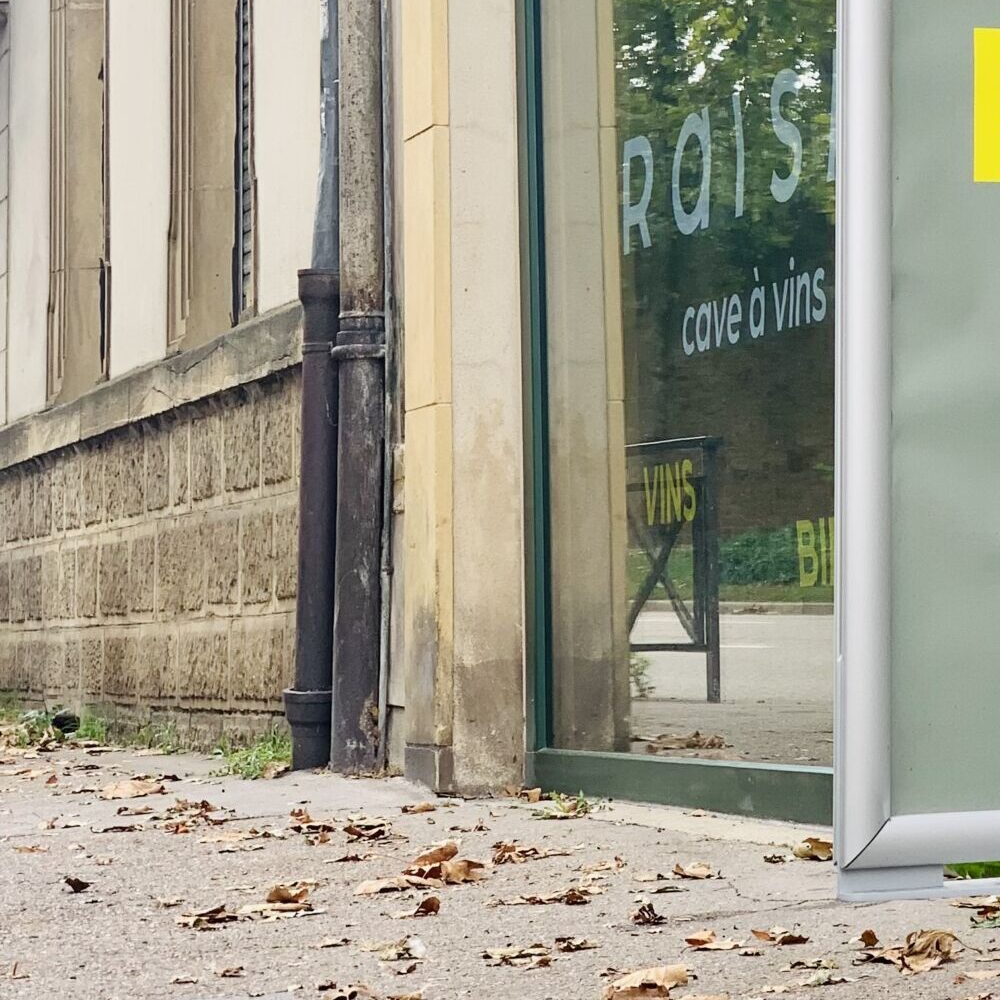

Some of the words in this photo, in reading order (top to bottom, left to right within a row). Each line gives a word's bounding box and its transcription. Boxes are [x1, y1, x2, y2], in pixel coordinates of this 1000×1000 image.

[681, 293, 742, 356] cave
[749, 266, 765, 339] à
[772, 256, 828, 331] vins
[643, 459, 697, 525] VINS
